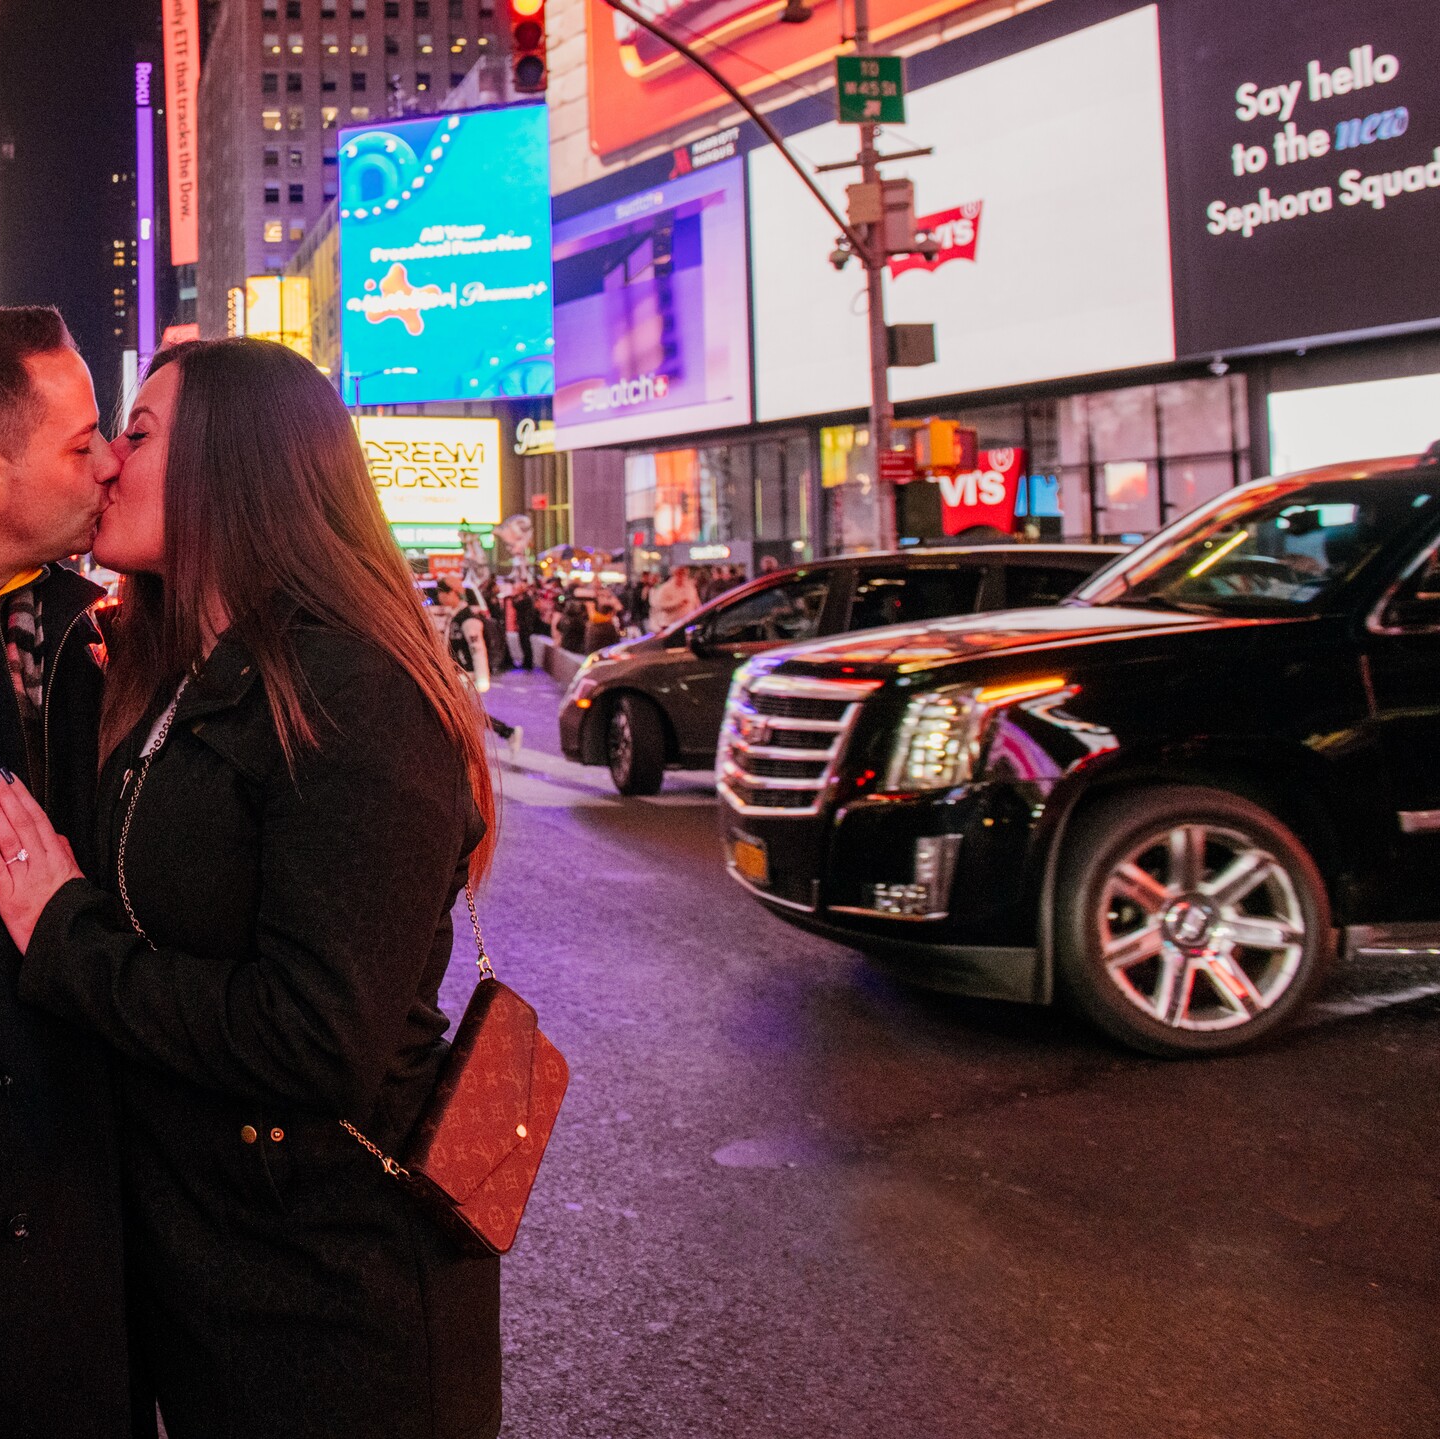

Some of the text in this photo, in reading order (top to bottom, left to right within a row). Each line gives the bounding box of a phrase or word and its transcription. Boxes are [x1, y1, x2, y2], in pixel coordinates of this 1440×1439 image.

[174, 29, 188, 58] ETF
[175, 62, 189, 95] that
[1235, 44, 1399, 122] Say hello
[176, 98, 191, 148] tracks
[1232, 106, 1408, 176] to the new
[178, 152, 192, 178] the
[180, 181, 193, 221] Dow.
[1206, 146, 1440, 238] Sephora Squad
[580, 372, 655, 413] swatch
[364, 440, 485, 464] DREAM
